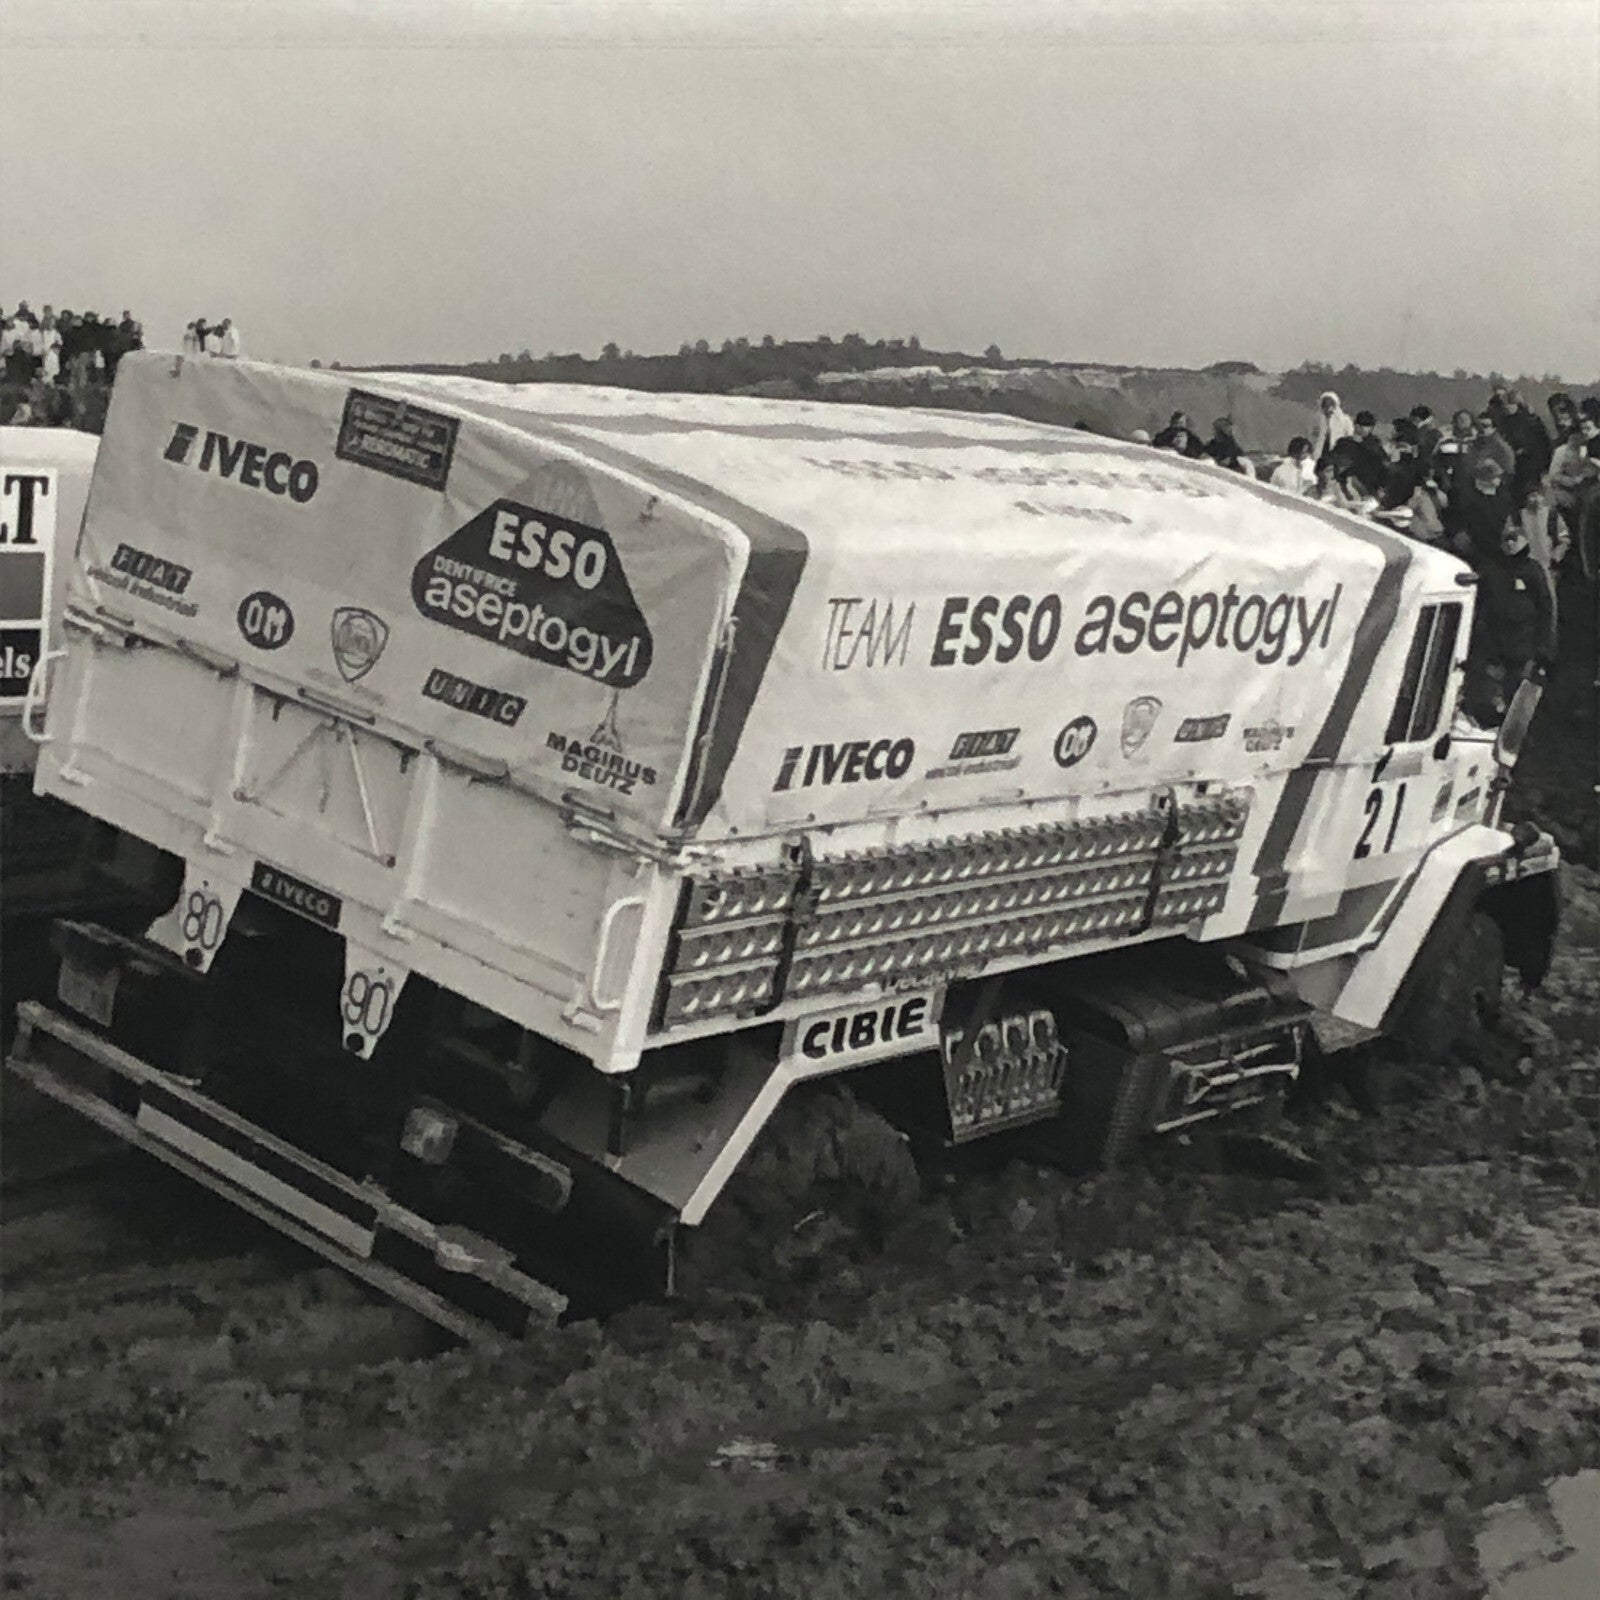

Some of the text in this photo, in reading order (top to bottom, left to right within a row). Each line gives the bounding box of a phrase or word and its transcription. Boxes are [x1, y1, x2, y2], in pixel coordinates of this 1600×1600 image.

[199, 431, 318, 503] IVECO
[0, 475, 49, 544] T
[117, 549, 187, 588] FIAT
[489, 511, 607, 589] ESSO
[244, 604, 287, 642] OM
[424, 576, 640, 678] aseptogyl
[823, 584, 1343, 670] TEAM ESSO aseptogyl
[429, 674, 518, 721] UNIC
[546, 732, 657, 785] MAGIRUS
[561, 754, 637, 795] DEUTZ
[802, 738, 914, 787] IVECO
[1353, 782, 1406, 859] 21
[184, 891, 223, 950] 80
[276, 876, 331, 916] IVECO
[344, 972, 389, 1036] 90
[803, 998, 927, 1060] CIBIE
